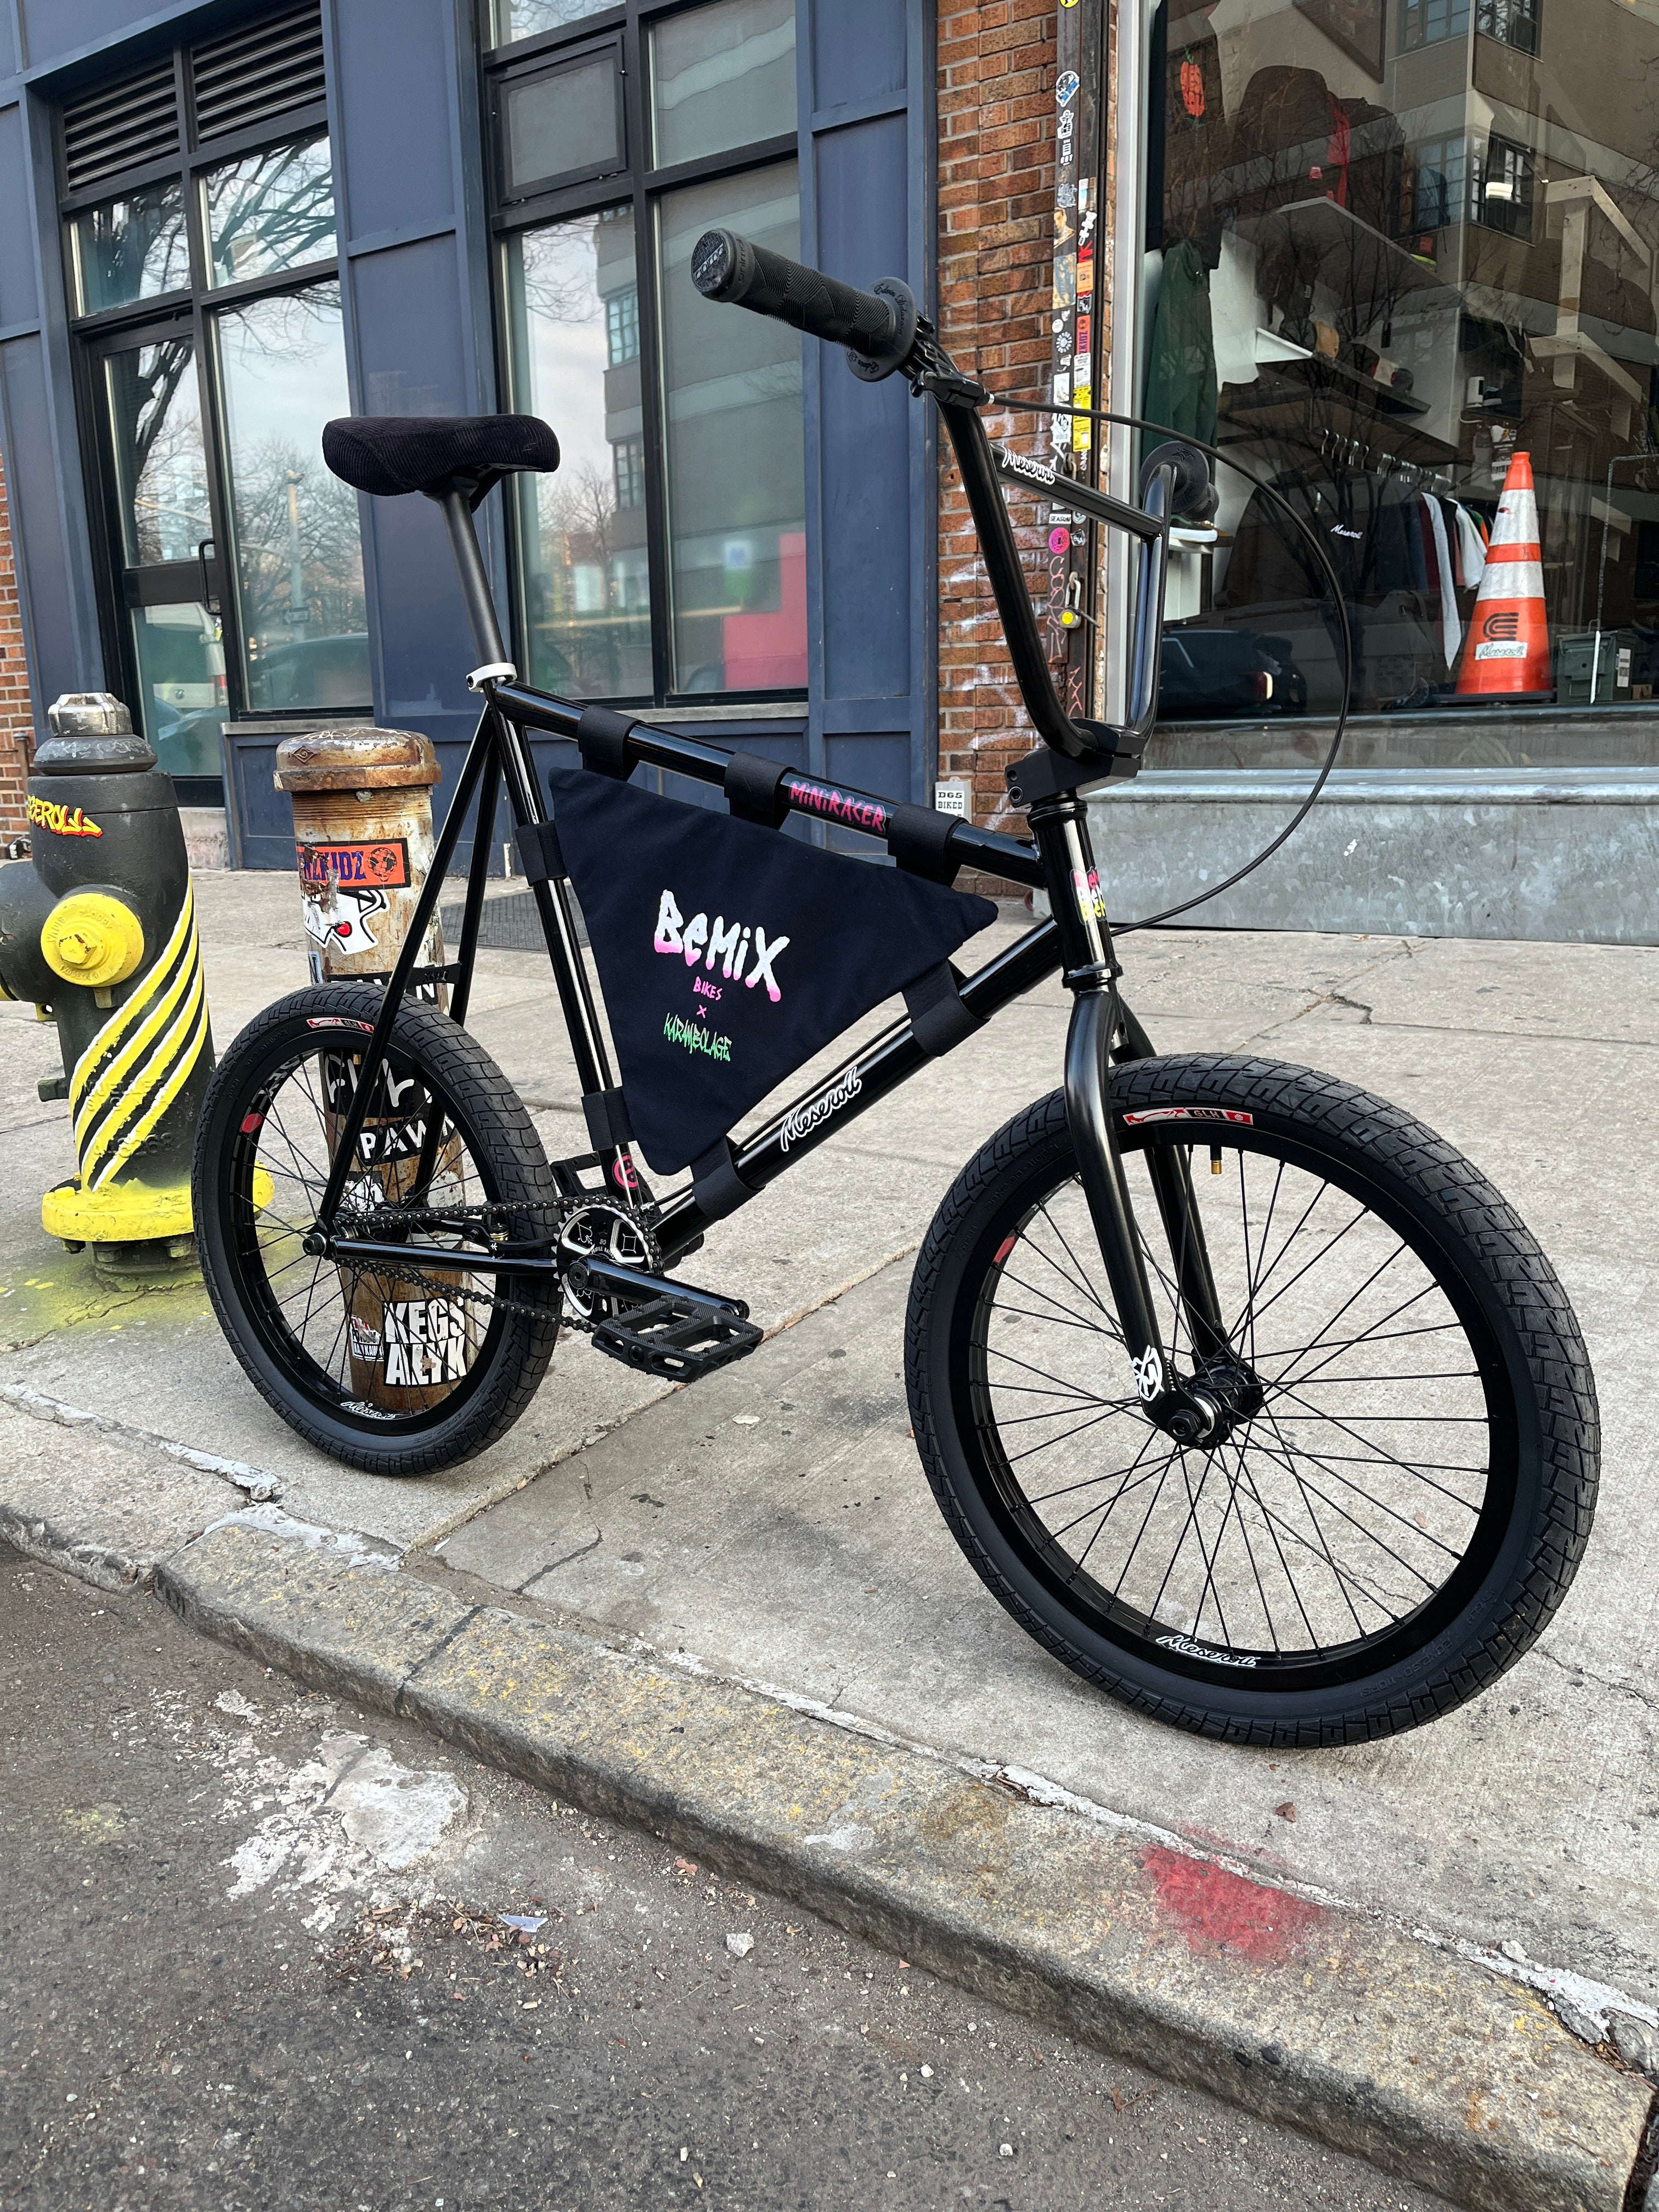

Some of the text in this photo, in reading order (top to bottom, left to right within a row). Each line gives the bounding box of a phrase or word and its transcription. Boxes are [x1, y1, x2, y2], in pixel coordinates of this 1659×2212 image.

[693, 976, 723, 1001] BIKES
[780, 1066, 862, 1152] Meseroll
[1193, 1109, 1220, 1119] GLH
[385, 1297, 466, 1344] KEGS
[385, 1335, 467, 1385] ALYK
